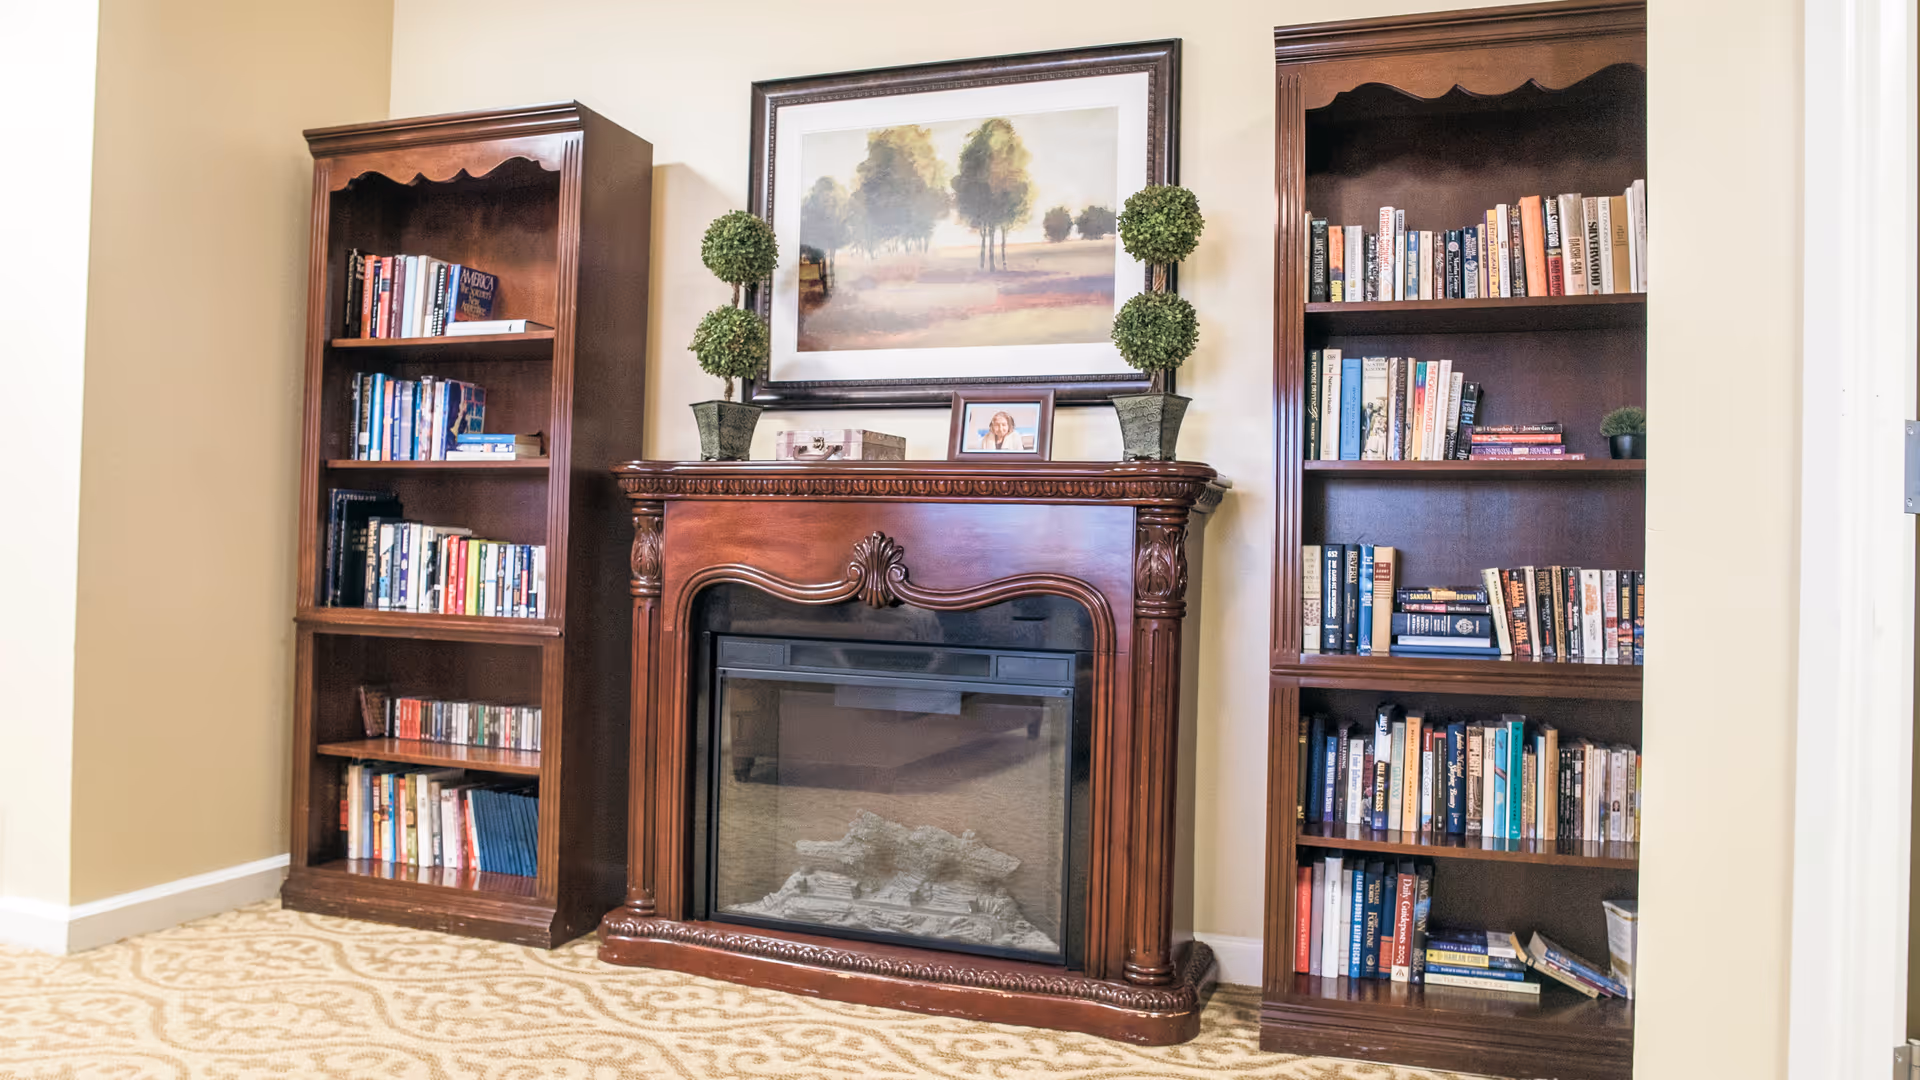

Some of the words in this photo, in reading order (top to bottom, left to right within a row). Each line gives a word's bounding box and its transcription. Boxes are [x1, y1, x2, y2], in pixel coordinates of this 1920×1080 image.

[1314, 238, 1324, 254] JAMES
[1588, 222, 1600, 286] SILVERWOOD
[1568, 238, 1582, 275] DAISHI-SAN
[1314, 254, 1324, 283] PATTERSON
[460, 269, 494, 290] AMERICA
[1425, 405, 1434, 432] TRAVELED
[1377, 762, 1385, 774] KILL
[1423, 754, 1431, 776] Maine
[1376, 774, 1385, 790] ALEX
[1423, 778, 1431, 796] Coast
[1376, 791, 1384, 811] CROSS
[1448, 788, 1457, 808] Beauty
[1355, 875, 1363, 891] FLASH
[1400, 878, 1412, 899] Daily
[1354, 892, 1363, 902] AND
[1354, 904, 1362, 922] BONES
[1398, 901, 1410, 944] Guideposts
[1353, 924, 1362, 941] KATHY
[1366, 912, 1377, 948] FORTUNE
[1352, 942, 1361, 965] REICHS
[1396, 946, 1406, 964] 2005
